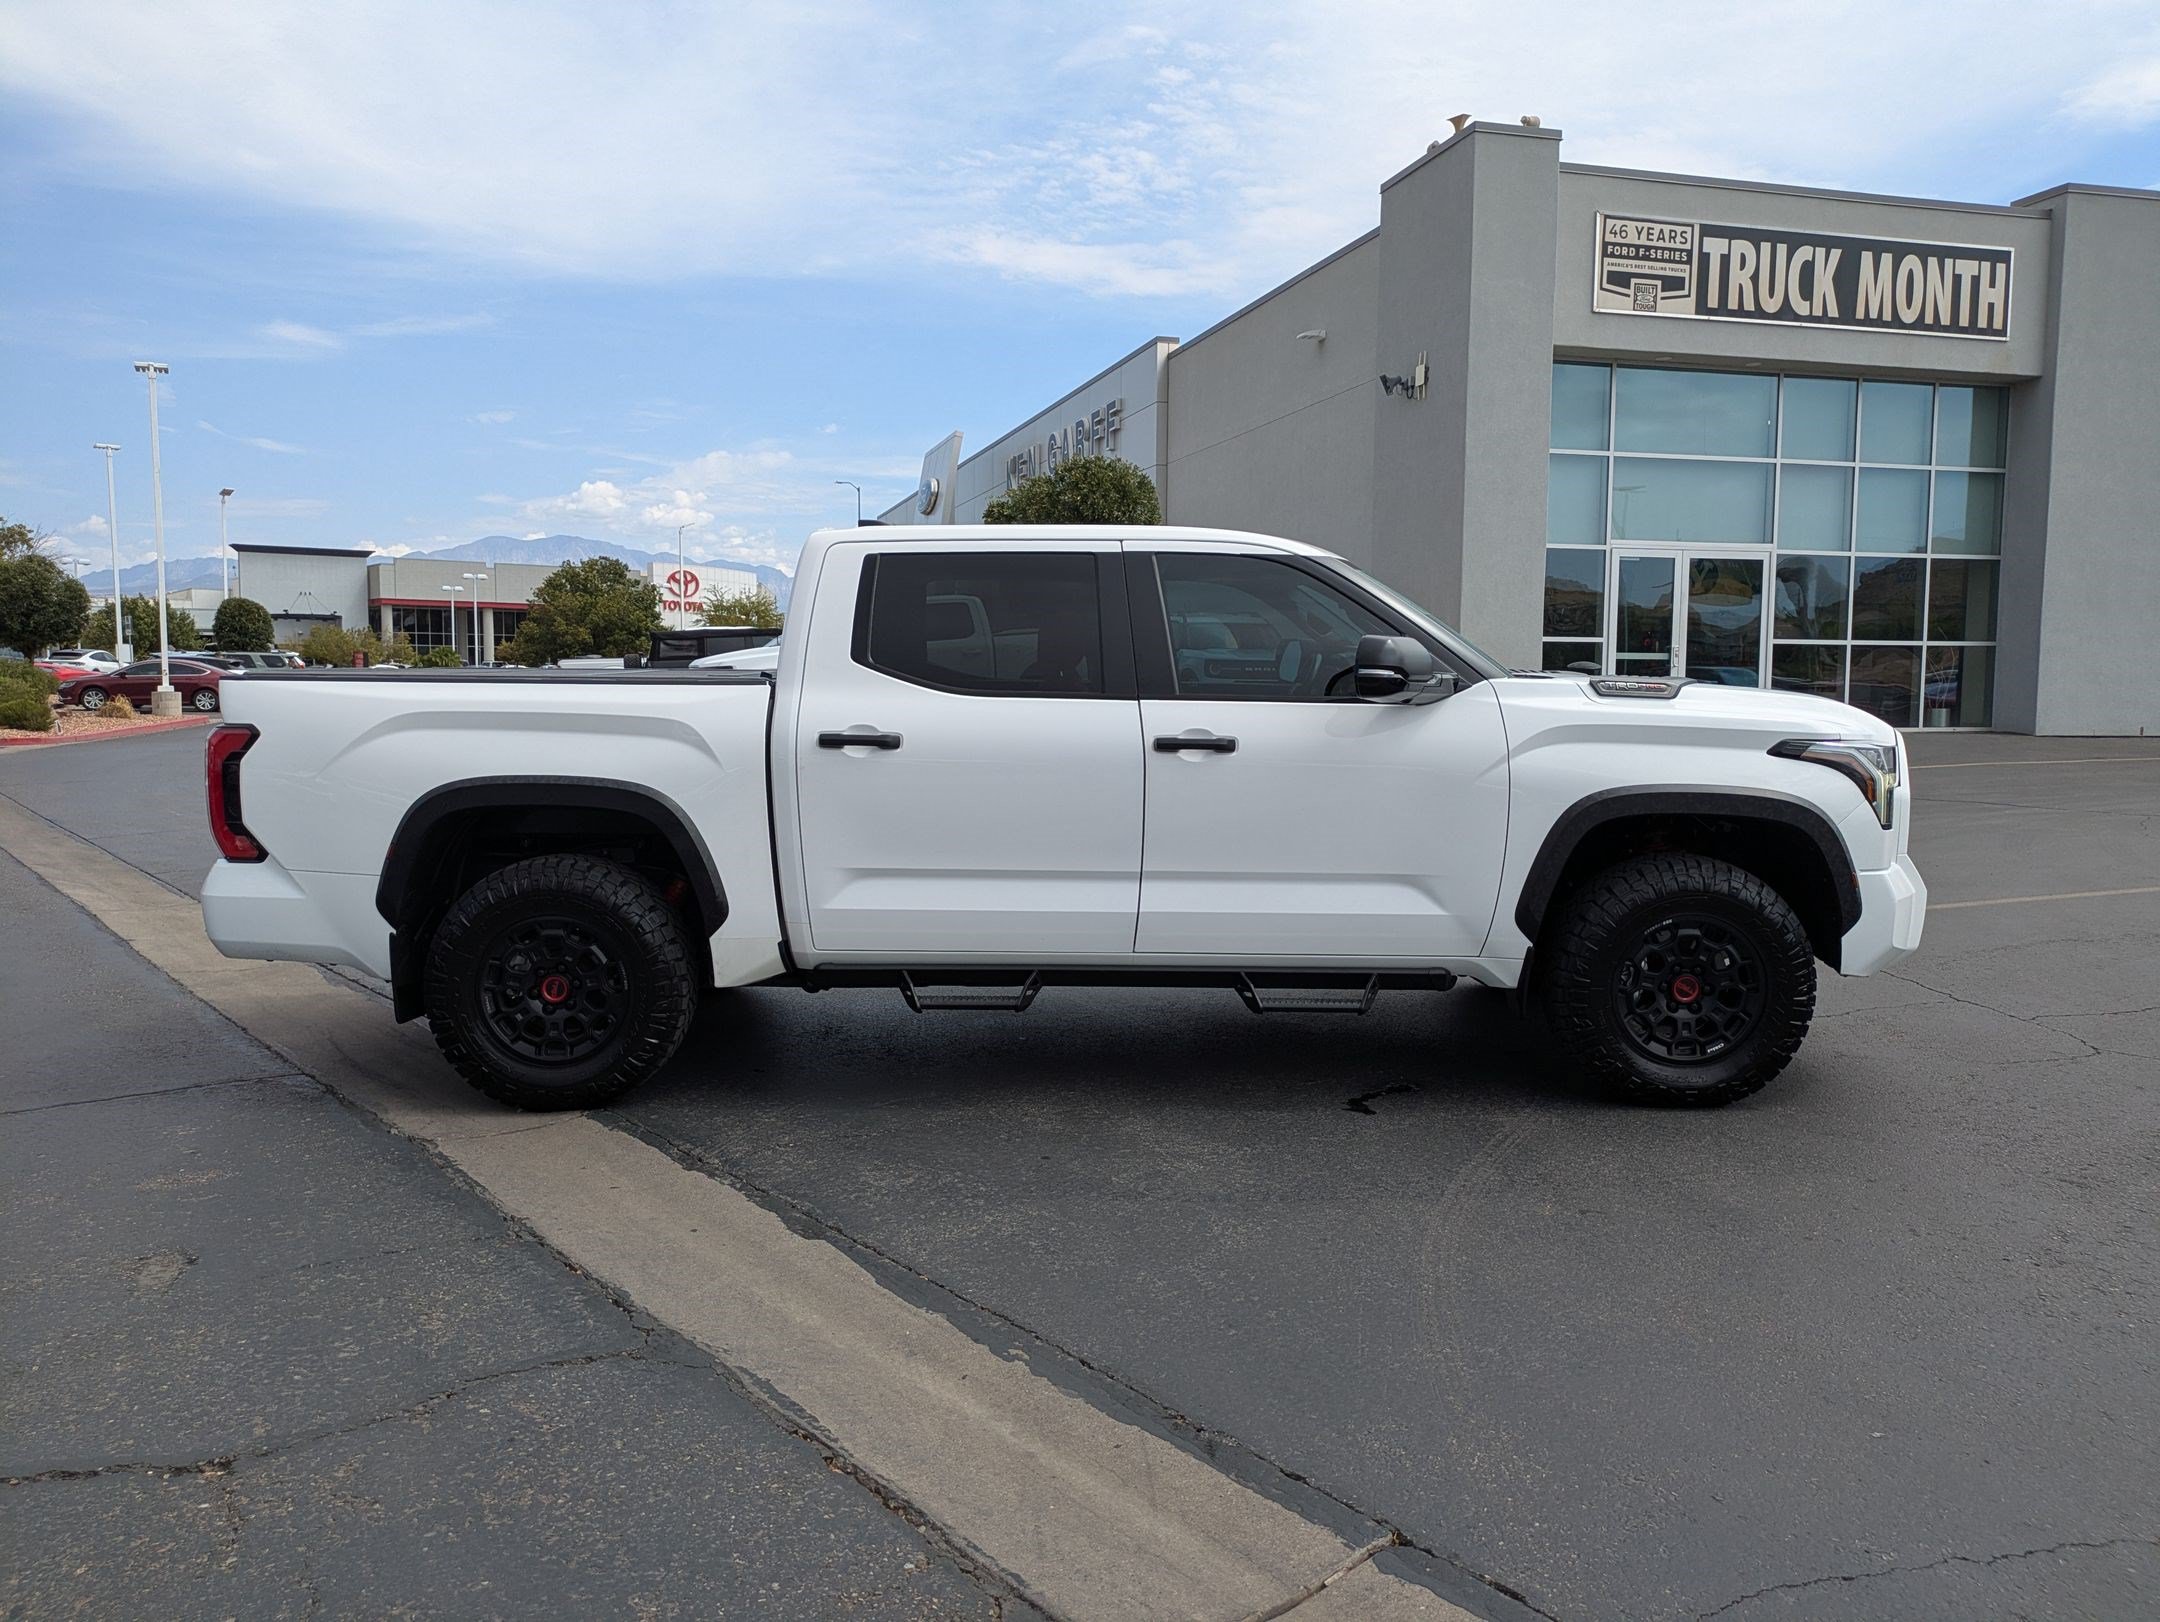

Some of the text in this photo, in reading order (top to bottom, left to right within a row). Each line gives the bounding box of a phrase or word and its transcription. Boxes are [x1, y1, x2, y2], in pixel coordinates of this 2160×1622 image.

[1609, 223, 1689, 245] 46 YEARS
[1607, 245, 1688, 261] FORD F-SERIES
[1606, 261, 1634, 269] AMERICA'S
[1702, 236, 2007, 330] TRUCK MONTH
[1636, 285, 1656, 295] BUILT
[1635, 302, 1656, 311] TOUGH
[1006, 399, 1122, 490] KEN GARFF
[1604, 681, 1638, 690] TRD
